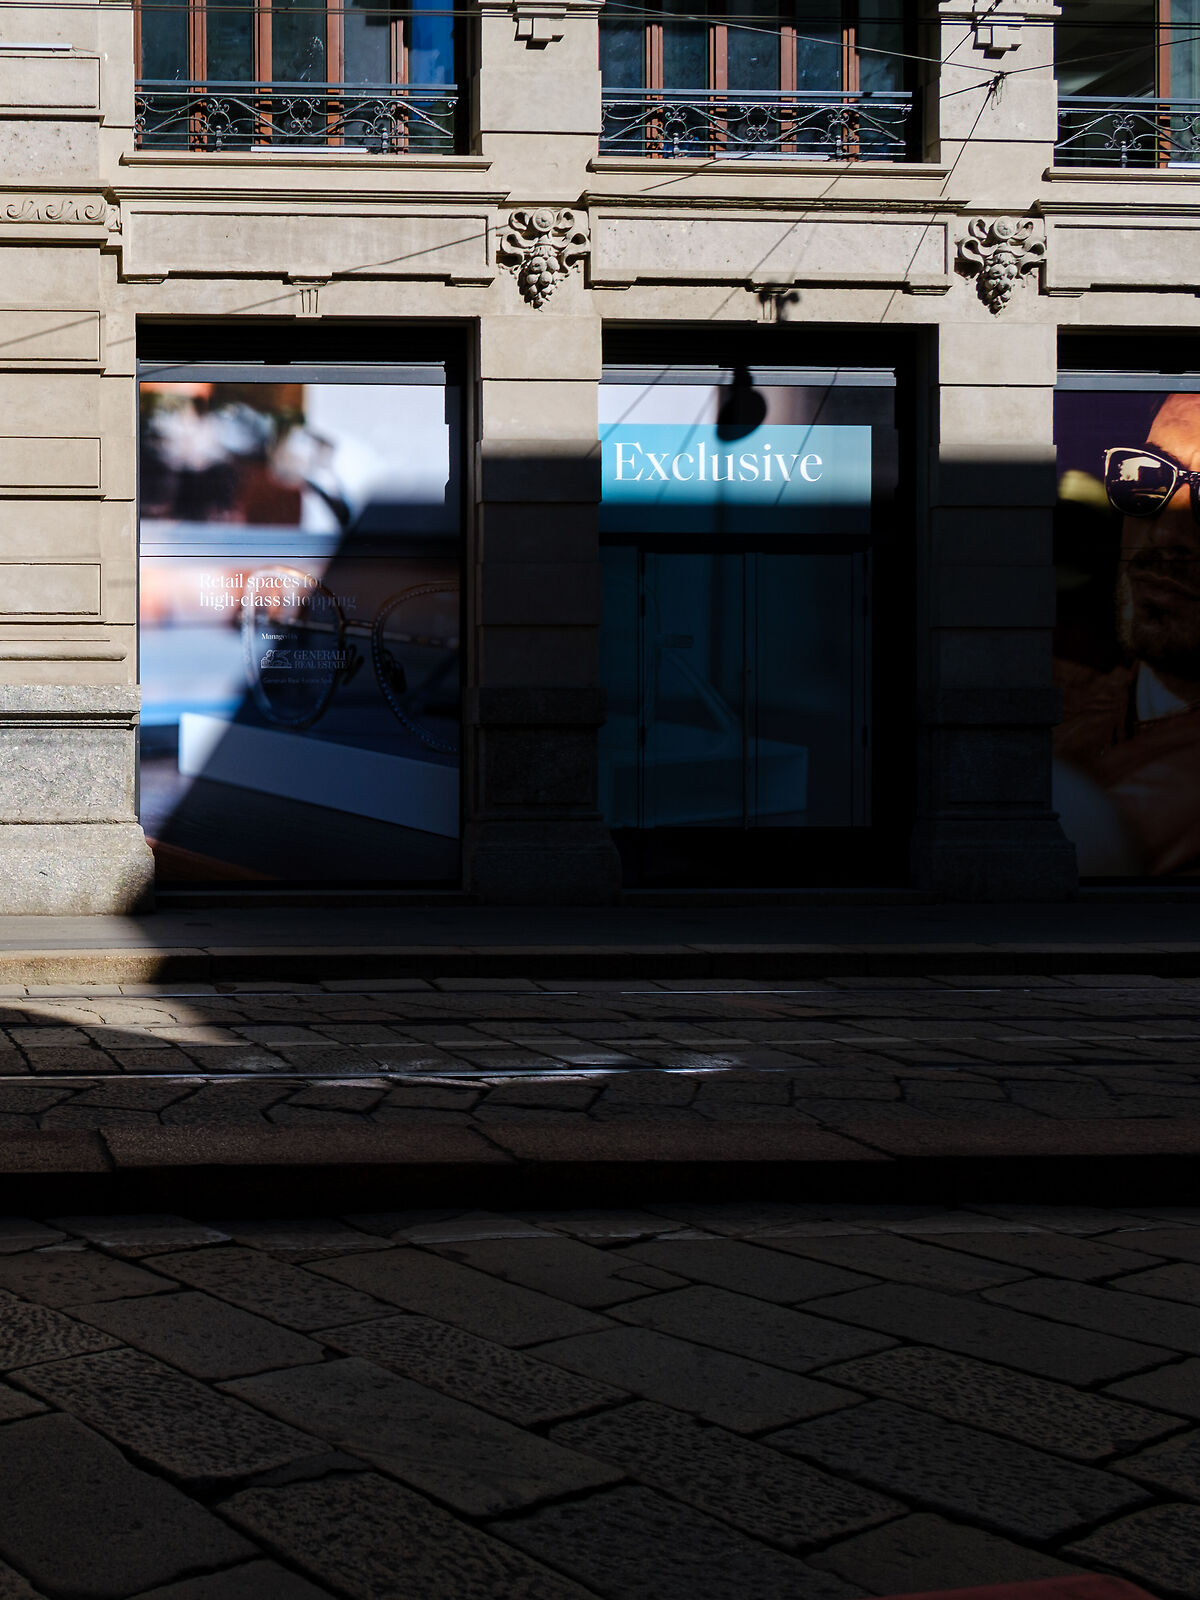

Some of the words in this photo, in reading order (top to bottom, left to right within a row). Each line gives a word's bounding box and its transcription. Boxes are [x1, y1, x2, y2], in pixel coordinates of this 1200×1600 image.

[612, 441, 824, 482] Exclusive
[199, 573, 243, 589] Retail
[246, 576, 300, 593] spaces
[303, 572, 324, 589] for
[199, 592, 280, 610] high-class
[283, 592, 358, 610] shopping
[293, 650, 346, 660] GENERALI
